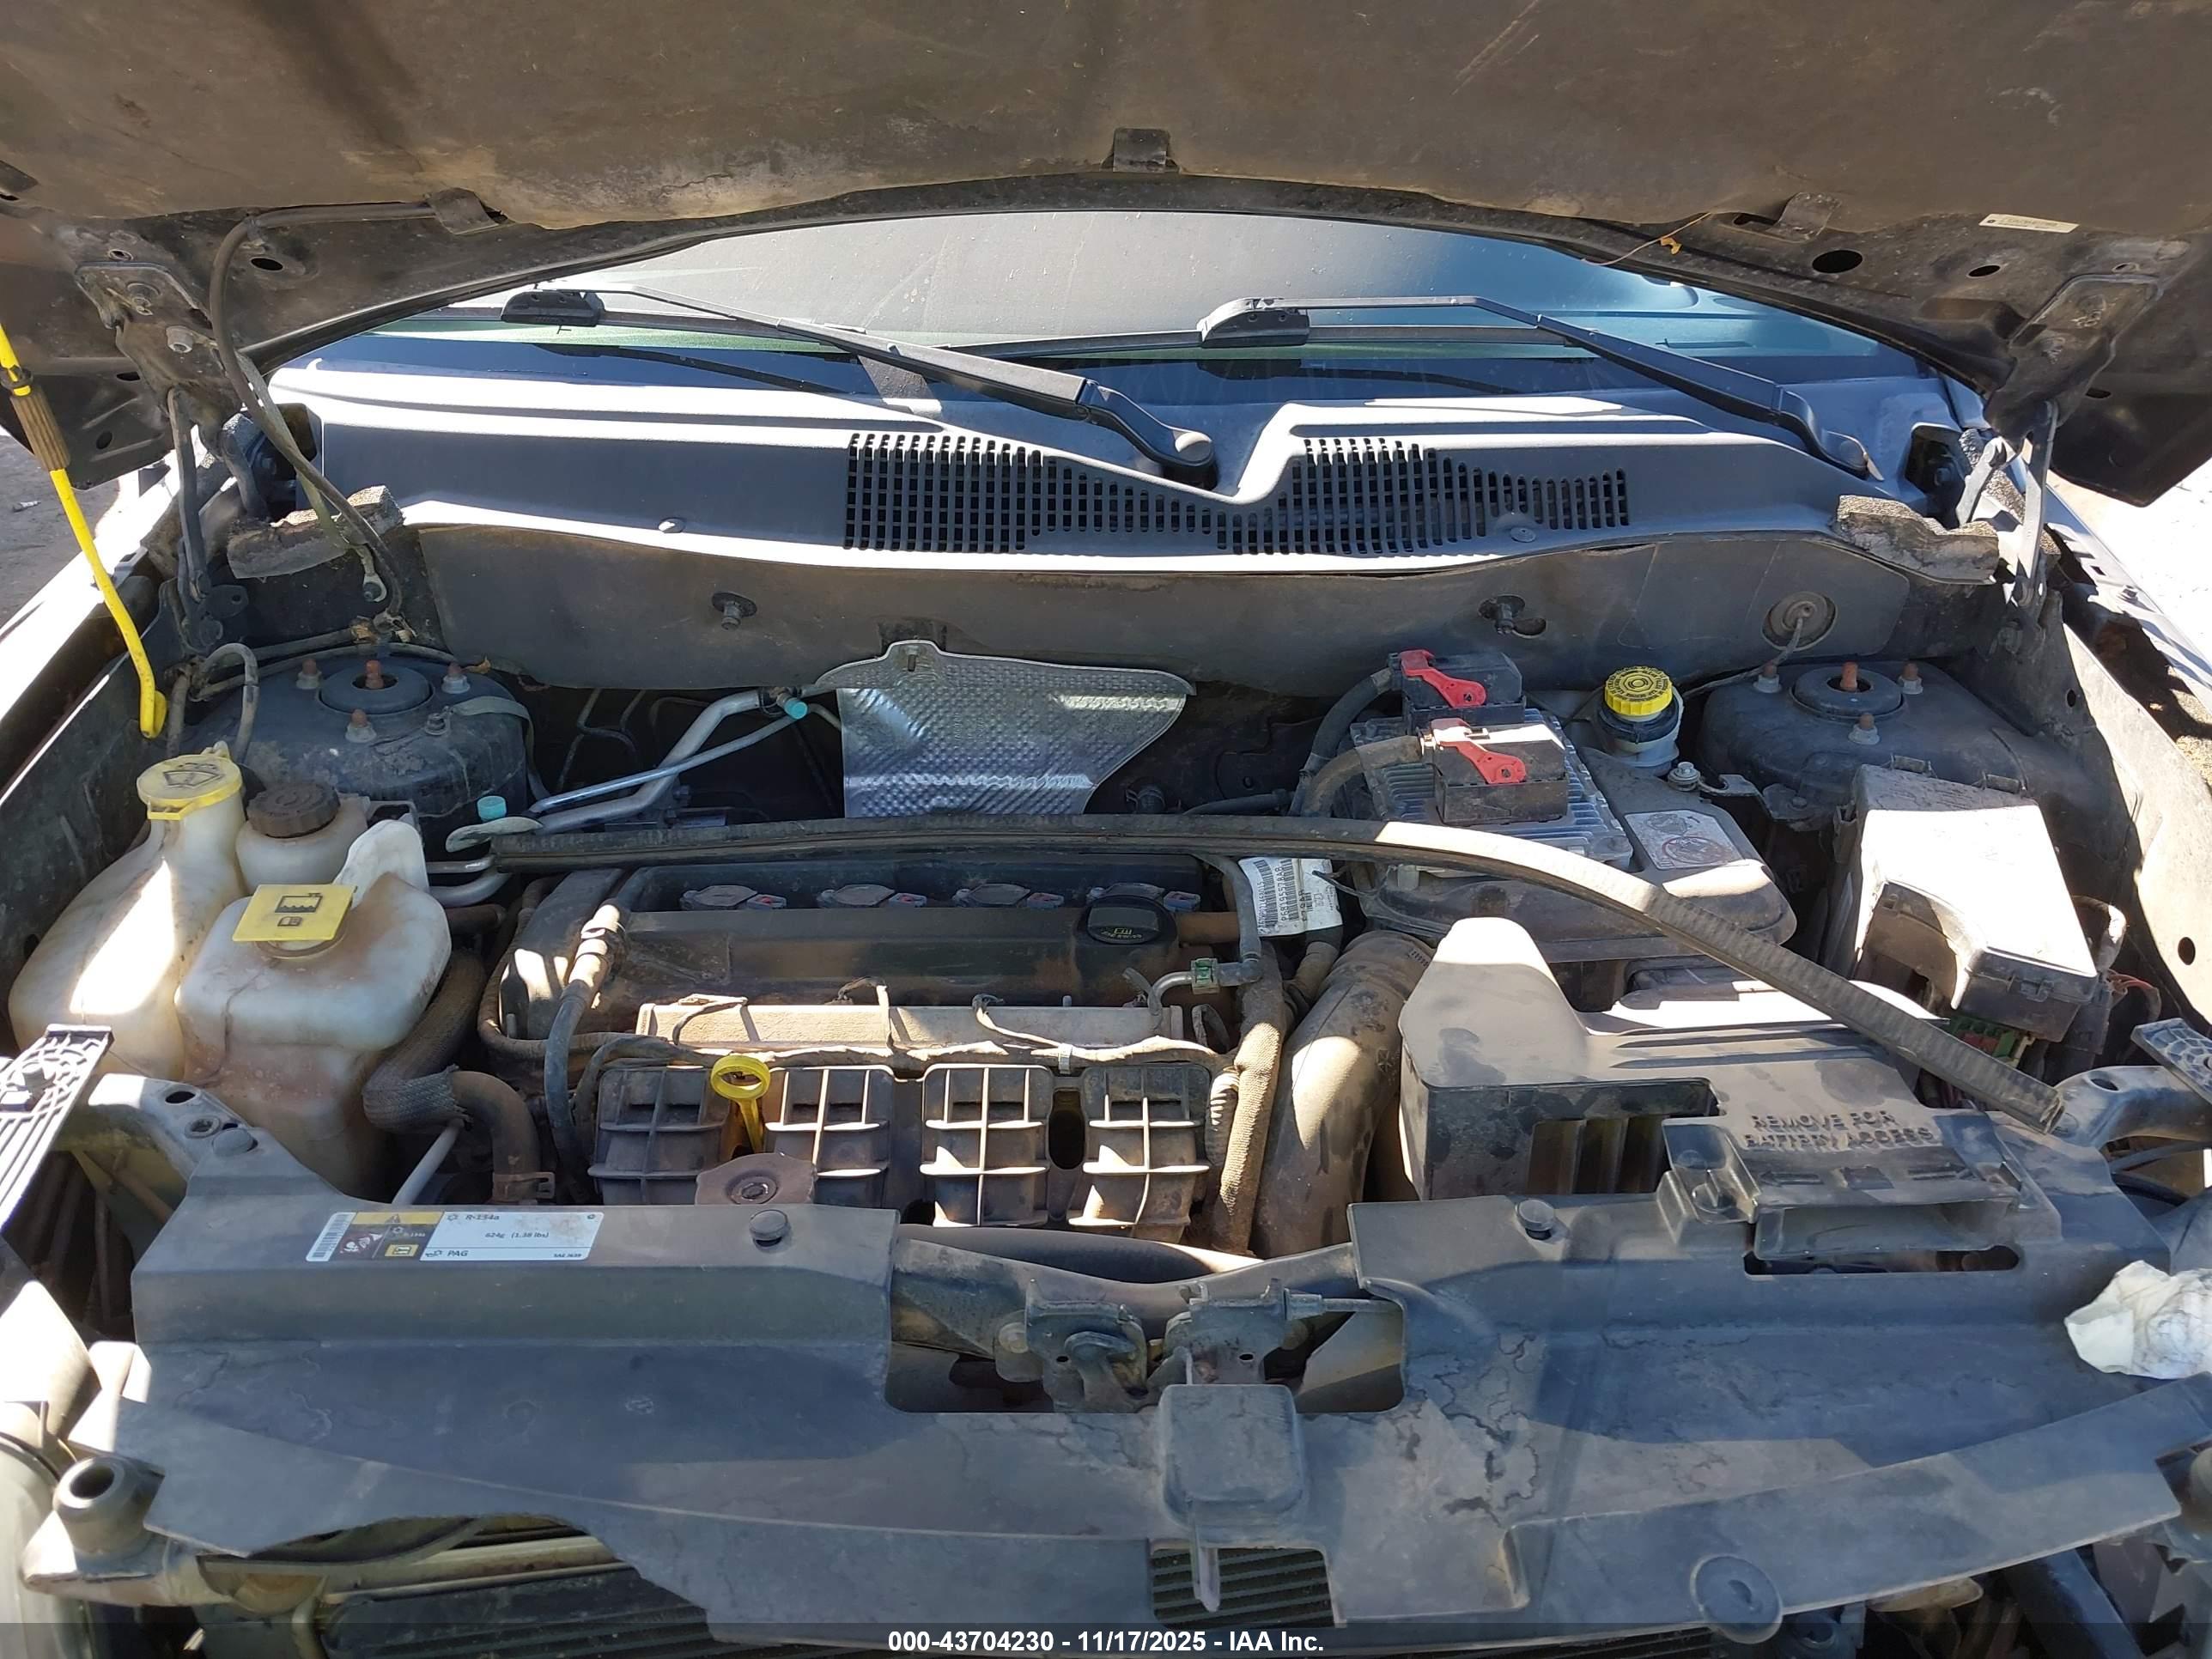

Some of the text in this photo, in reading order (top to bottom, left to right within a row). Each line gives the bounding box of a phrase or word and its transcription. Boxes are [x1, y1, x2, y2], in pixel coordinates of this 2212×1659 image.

[1751, 1110, 1898, 1130] REMOVE FOR
[1846, 1127, 1935, 1148] ACCESS
